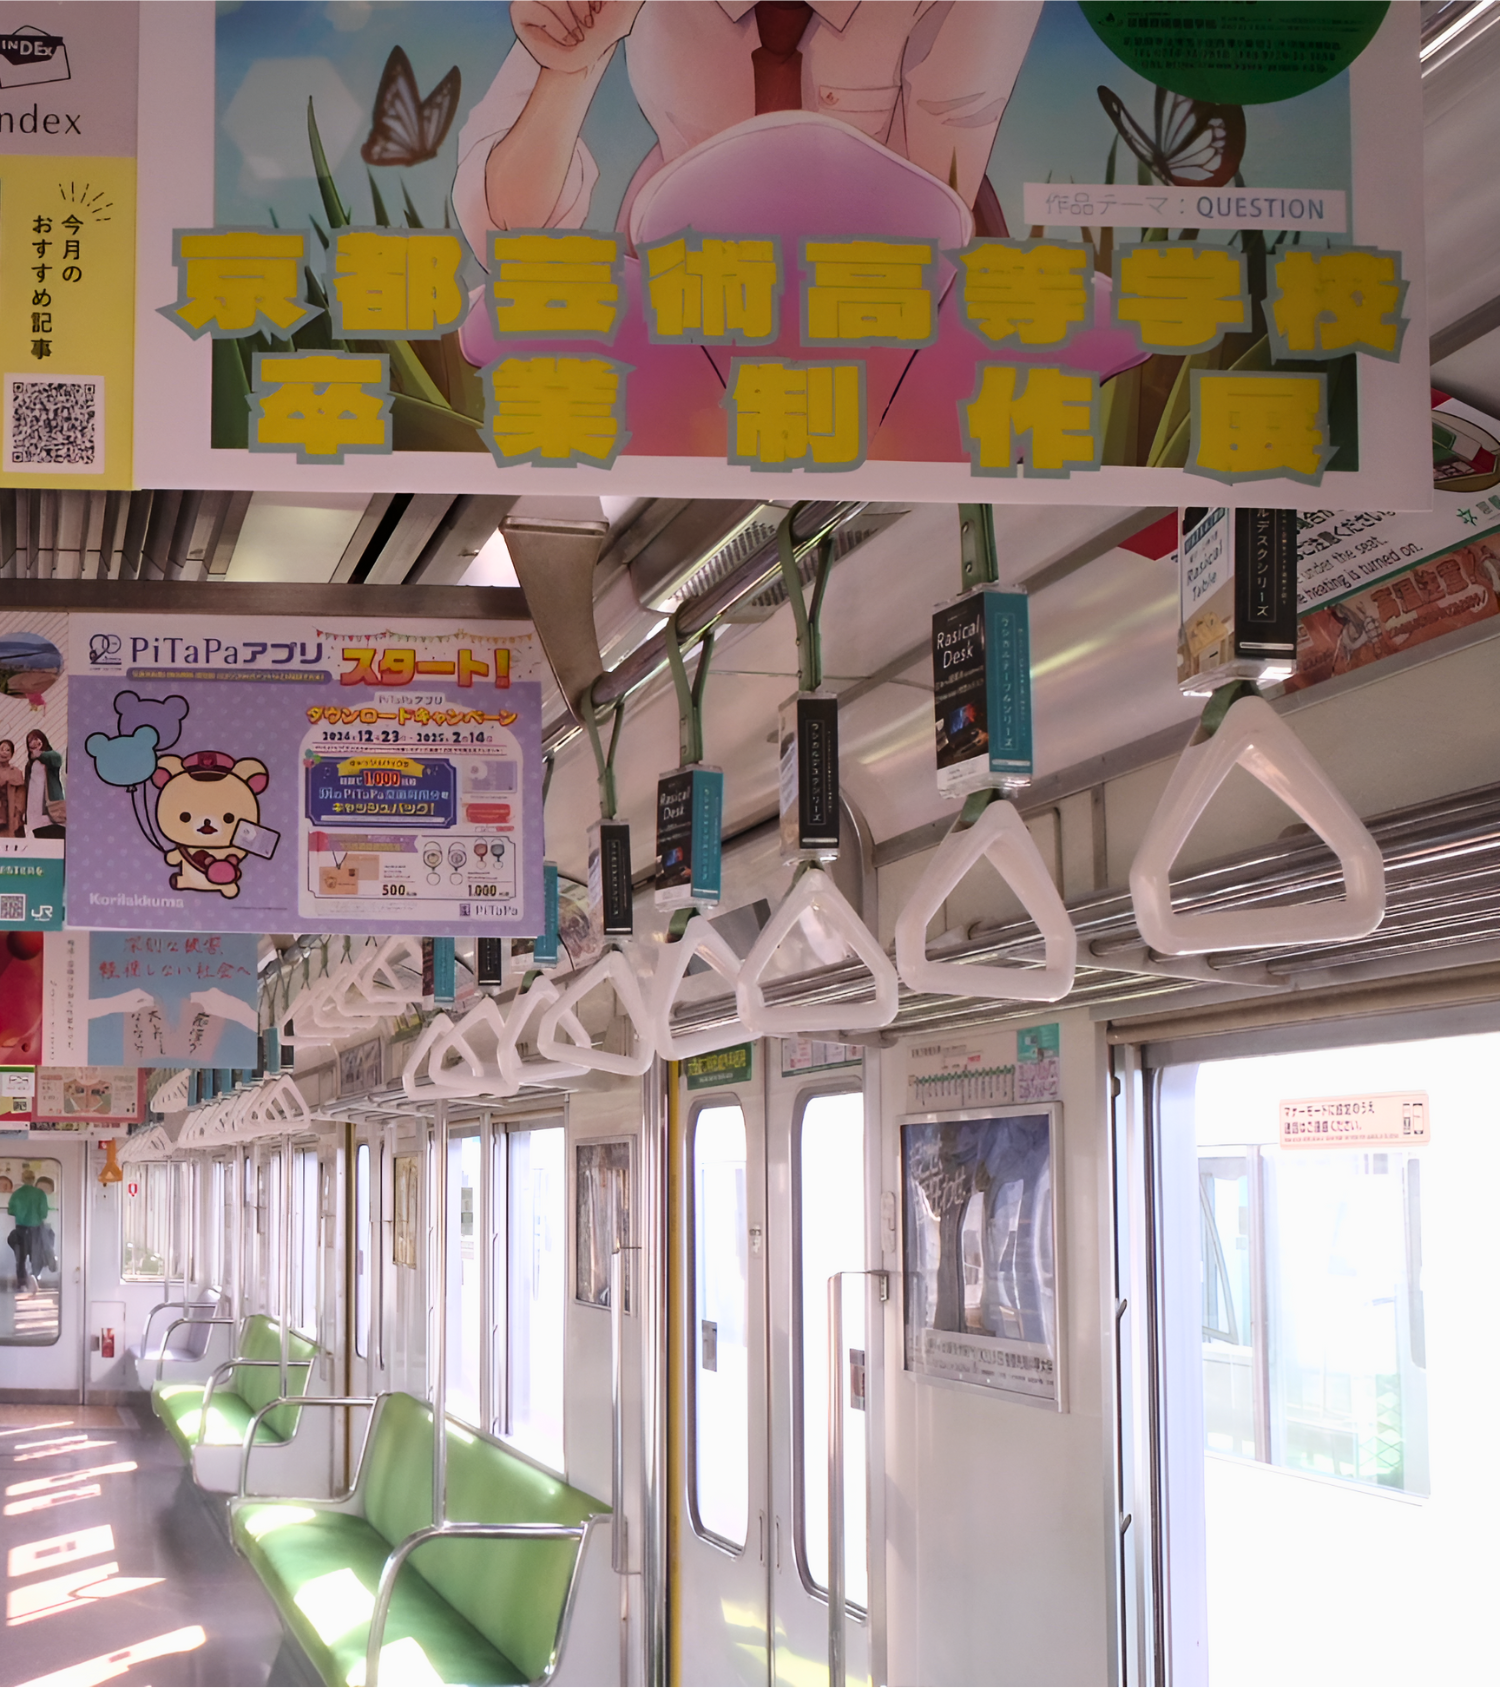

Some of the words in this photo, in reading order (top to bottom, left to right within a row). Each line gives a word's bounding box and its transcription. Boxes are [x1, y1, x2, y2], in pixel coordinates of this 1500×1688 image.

[1196, 196, 1325, 219] QUESTION
[60, 214, 83, 283] 今月の
[31, 214, 54, 361] おすすめ記事
[157, 226, 1408, 363] 京都芸術高等学校
[248, 350, 1338, 484] 卒業制作展
[1304, 573, 1352, 601] heating
[1358, 548, 1402, 575] turned
[1399, 542, 1424, 557] on.
[1332, 548, 1357, 564] the
[937, 613, 980, 650] Rasical
[942, 640, 975, 669] Desk
[306, 704, 518, 727] ダウンロードキャンペーン
